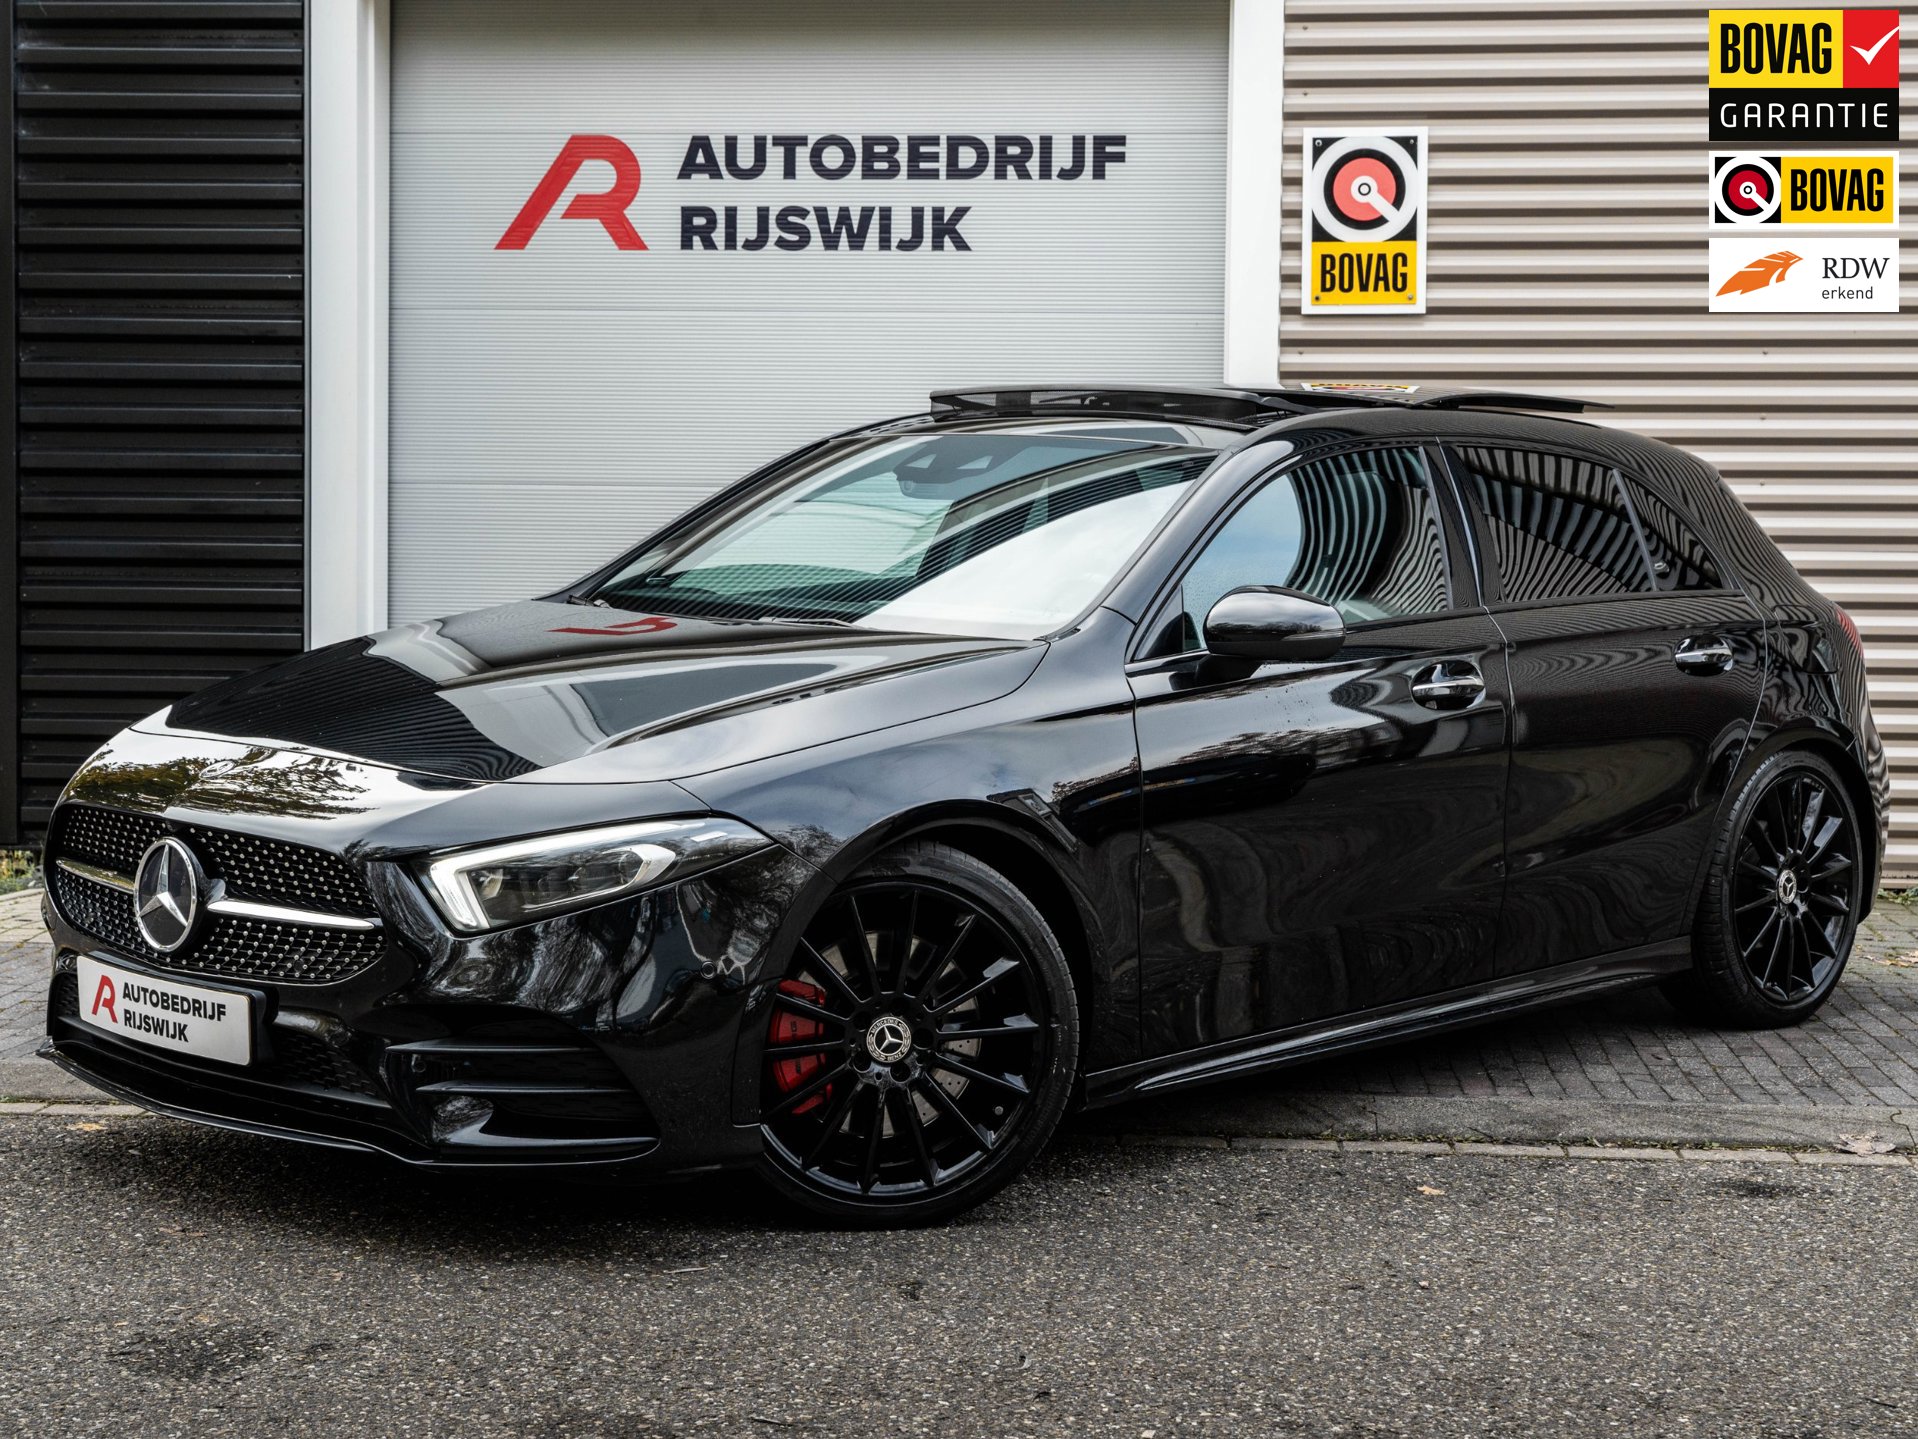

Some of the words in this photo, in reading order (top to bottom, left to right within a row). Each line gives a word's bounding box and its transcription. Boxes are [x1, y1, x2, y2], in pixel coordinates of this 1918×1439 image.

[677, 135, 1127, 181] AUTOBEDRIJF
[680, 205, 972, 252] RIJSWIJK
[1320, 252, 1408, 293] BOVAG
[122, 982, 227, 1022] AUTOBEDRIJF
[123, 1009, 189, 1043] RIJSWIJK
